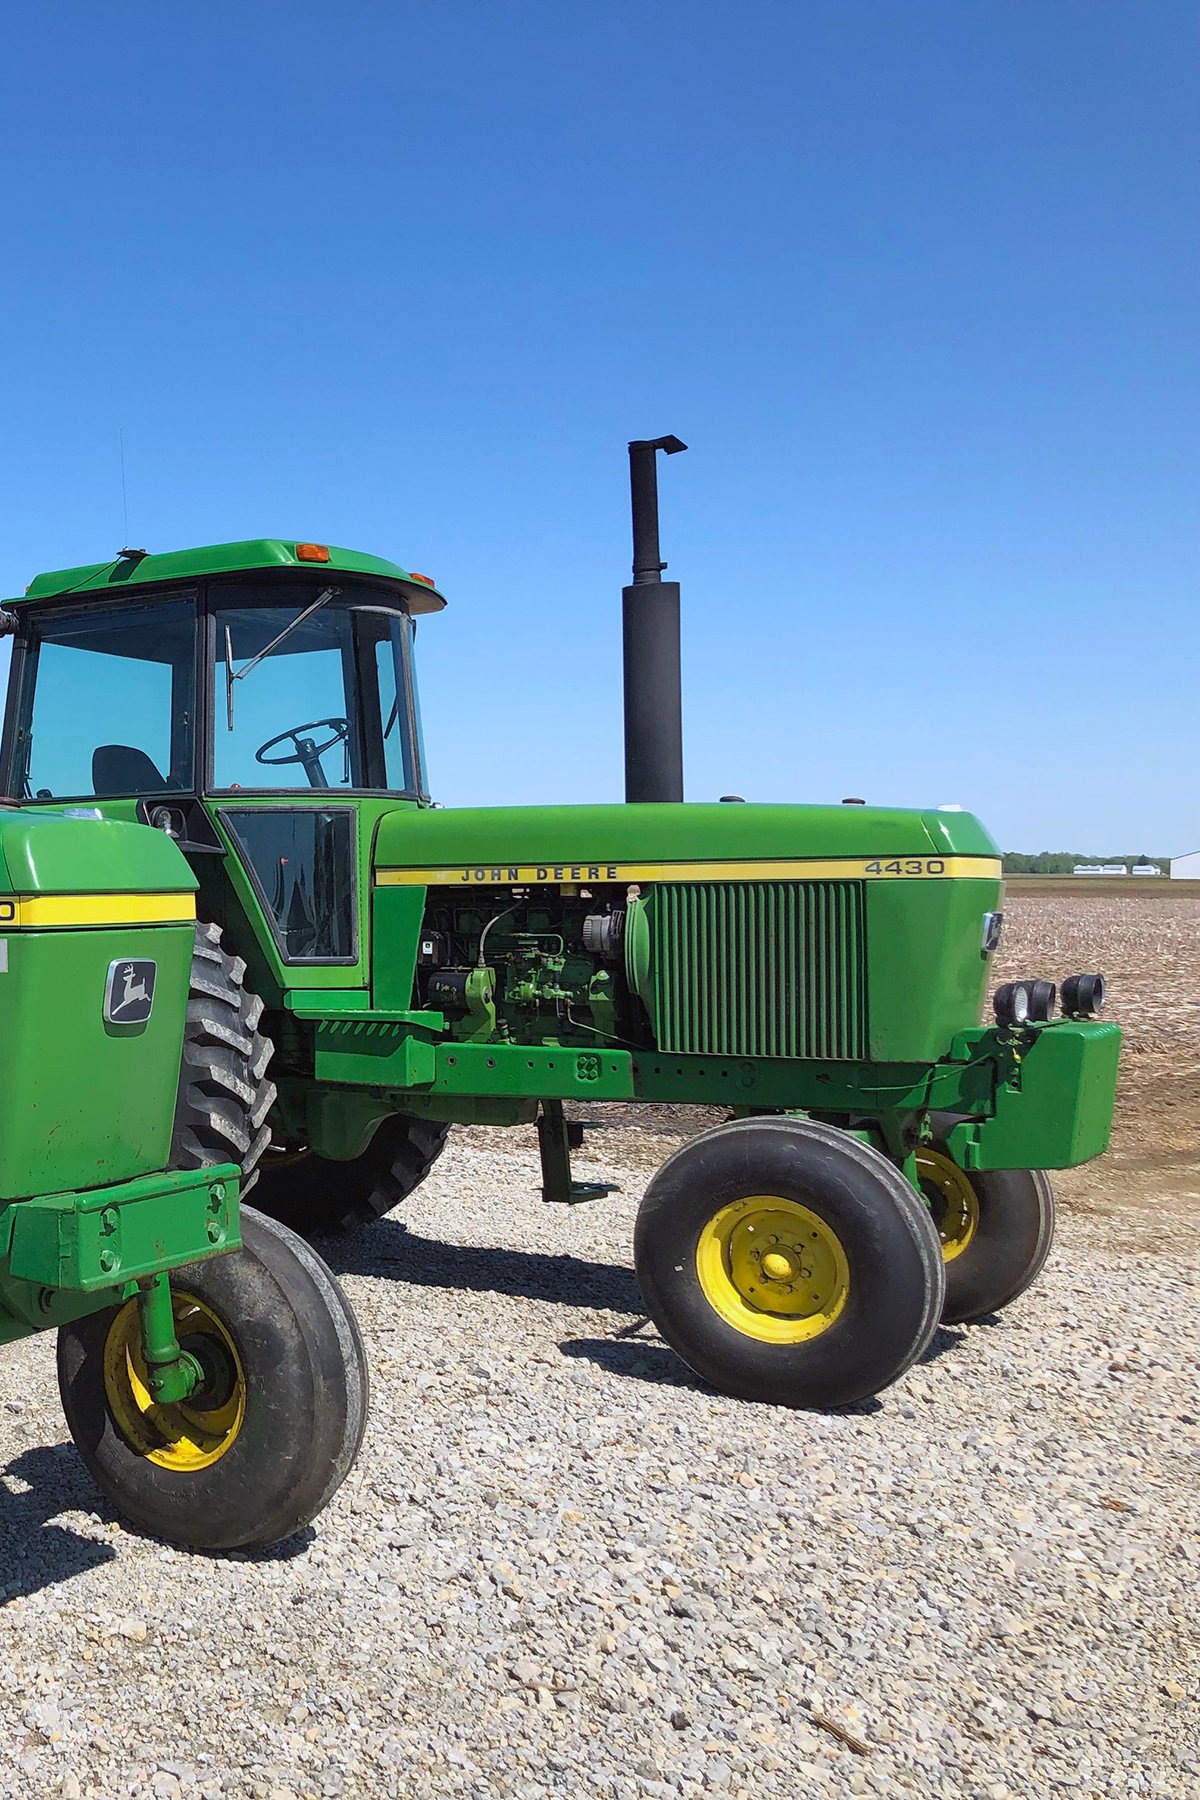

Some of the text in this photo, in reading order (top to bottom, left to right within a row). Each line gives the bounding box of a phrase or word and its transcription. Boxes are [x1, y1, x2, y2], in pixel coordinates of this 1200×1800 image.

[461, 866, 617, 881] JOHN DEERE
[864, 860, 945, 875] 4430
